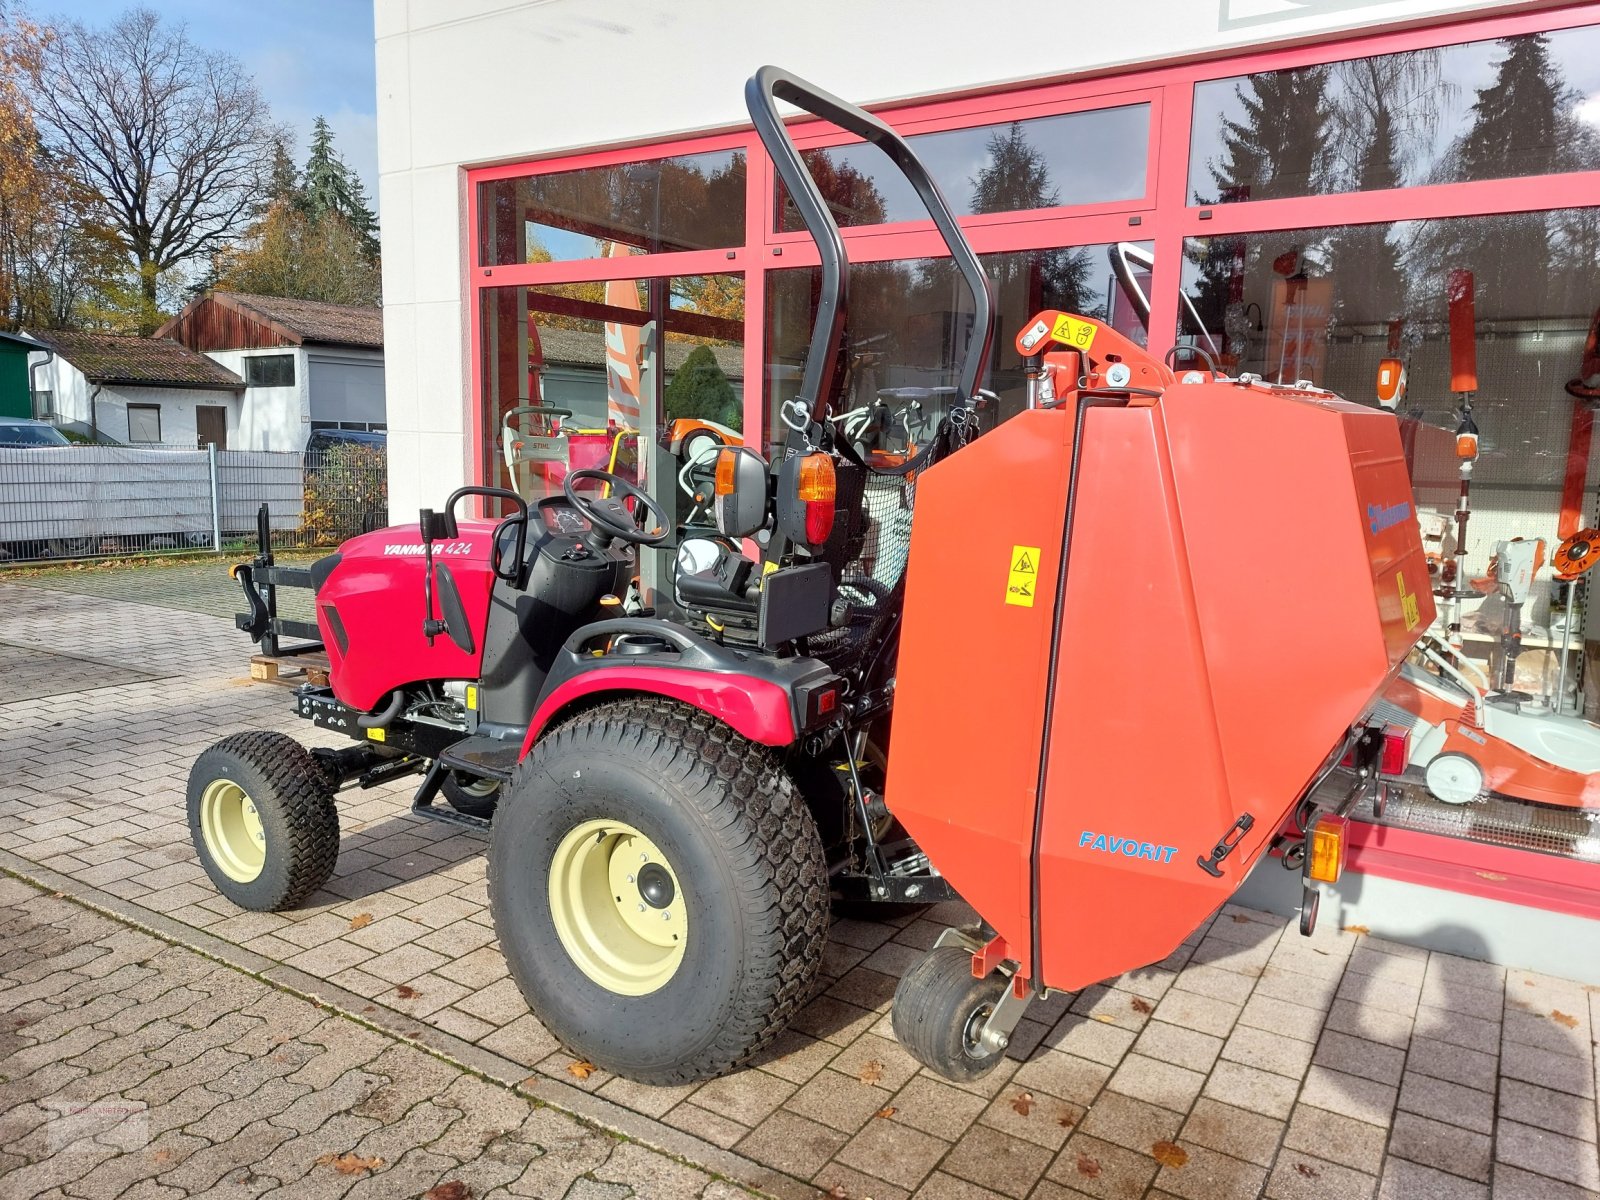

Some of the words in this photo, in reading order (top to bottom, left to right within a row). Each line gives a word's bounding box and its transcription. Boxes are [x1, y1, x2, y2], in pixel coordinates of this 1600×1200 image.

[533, 442, 550, 450] STIHL
[445, 542, 473, 555] 424
[1078, 831, 1179, 864] FAVORIT
